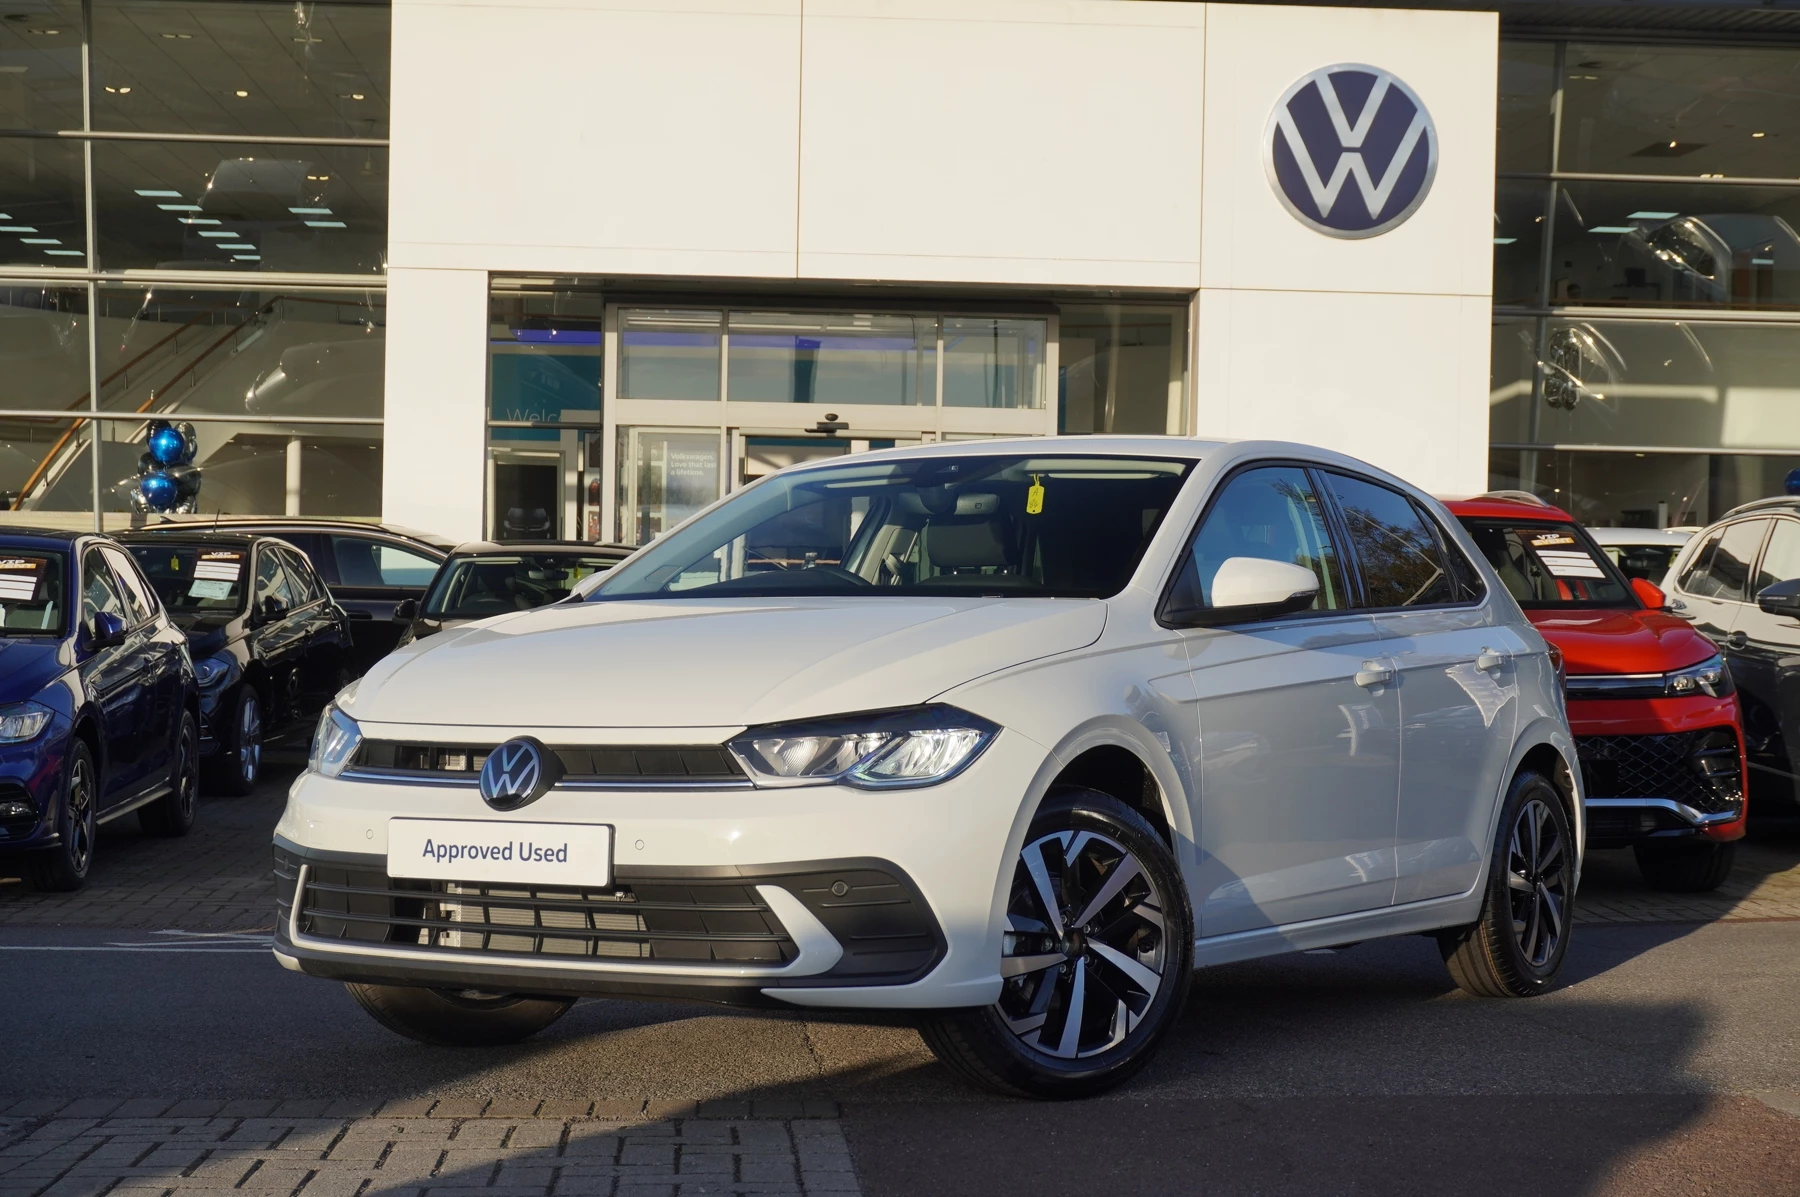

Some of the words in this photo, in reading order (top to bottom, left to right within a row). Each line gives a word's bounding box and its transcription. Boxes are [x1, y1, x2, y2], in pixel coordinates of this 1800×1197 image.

[1270, 66, 1431, 221] VW
[506, 408, 561, 422] Welc
[670, 452, 715, 461] Volkswagen.
[1531, 537, 1574, 546] EVENT
[482, 740, 541, 799] VW
[422, 838, 514, 864] Approved
[518, 841, 568, 863] Used
